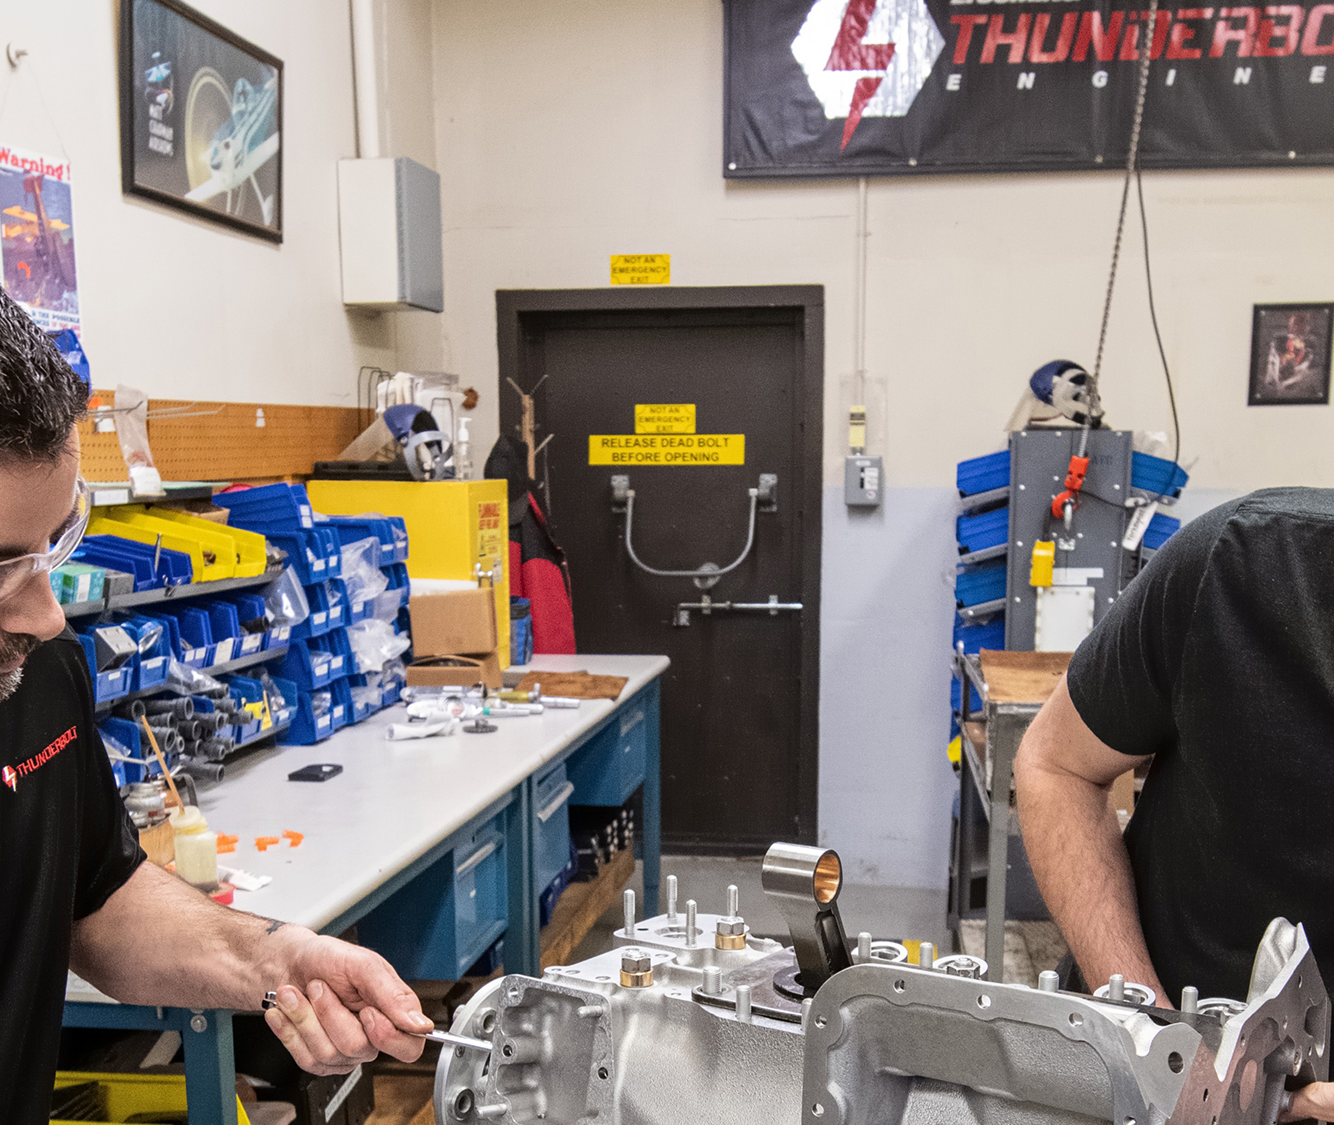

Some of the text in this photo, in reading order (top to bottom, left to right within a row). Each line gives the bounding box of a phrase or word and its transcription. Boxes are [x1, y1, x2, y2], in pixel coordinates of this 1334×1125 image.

[623, 256, 656, 264] NOT AN
[611, 265, 667, 274] EMERGENCY
[630, 275, 649, 284] EXIT
[649, 406, 680, 414] NOT AN
[638, 415, 691, 423] EMERGENCY
[656, 425, 674, 433] EXIT
[601, 437, 730, 448] RELEASE DEAD BOLT
[612, 452, 719, 462] BEFORE OPENING
[16, 726, 78, 777] THUNDERBOLT
